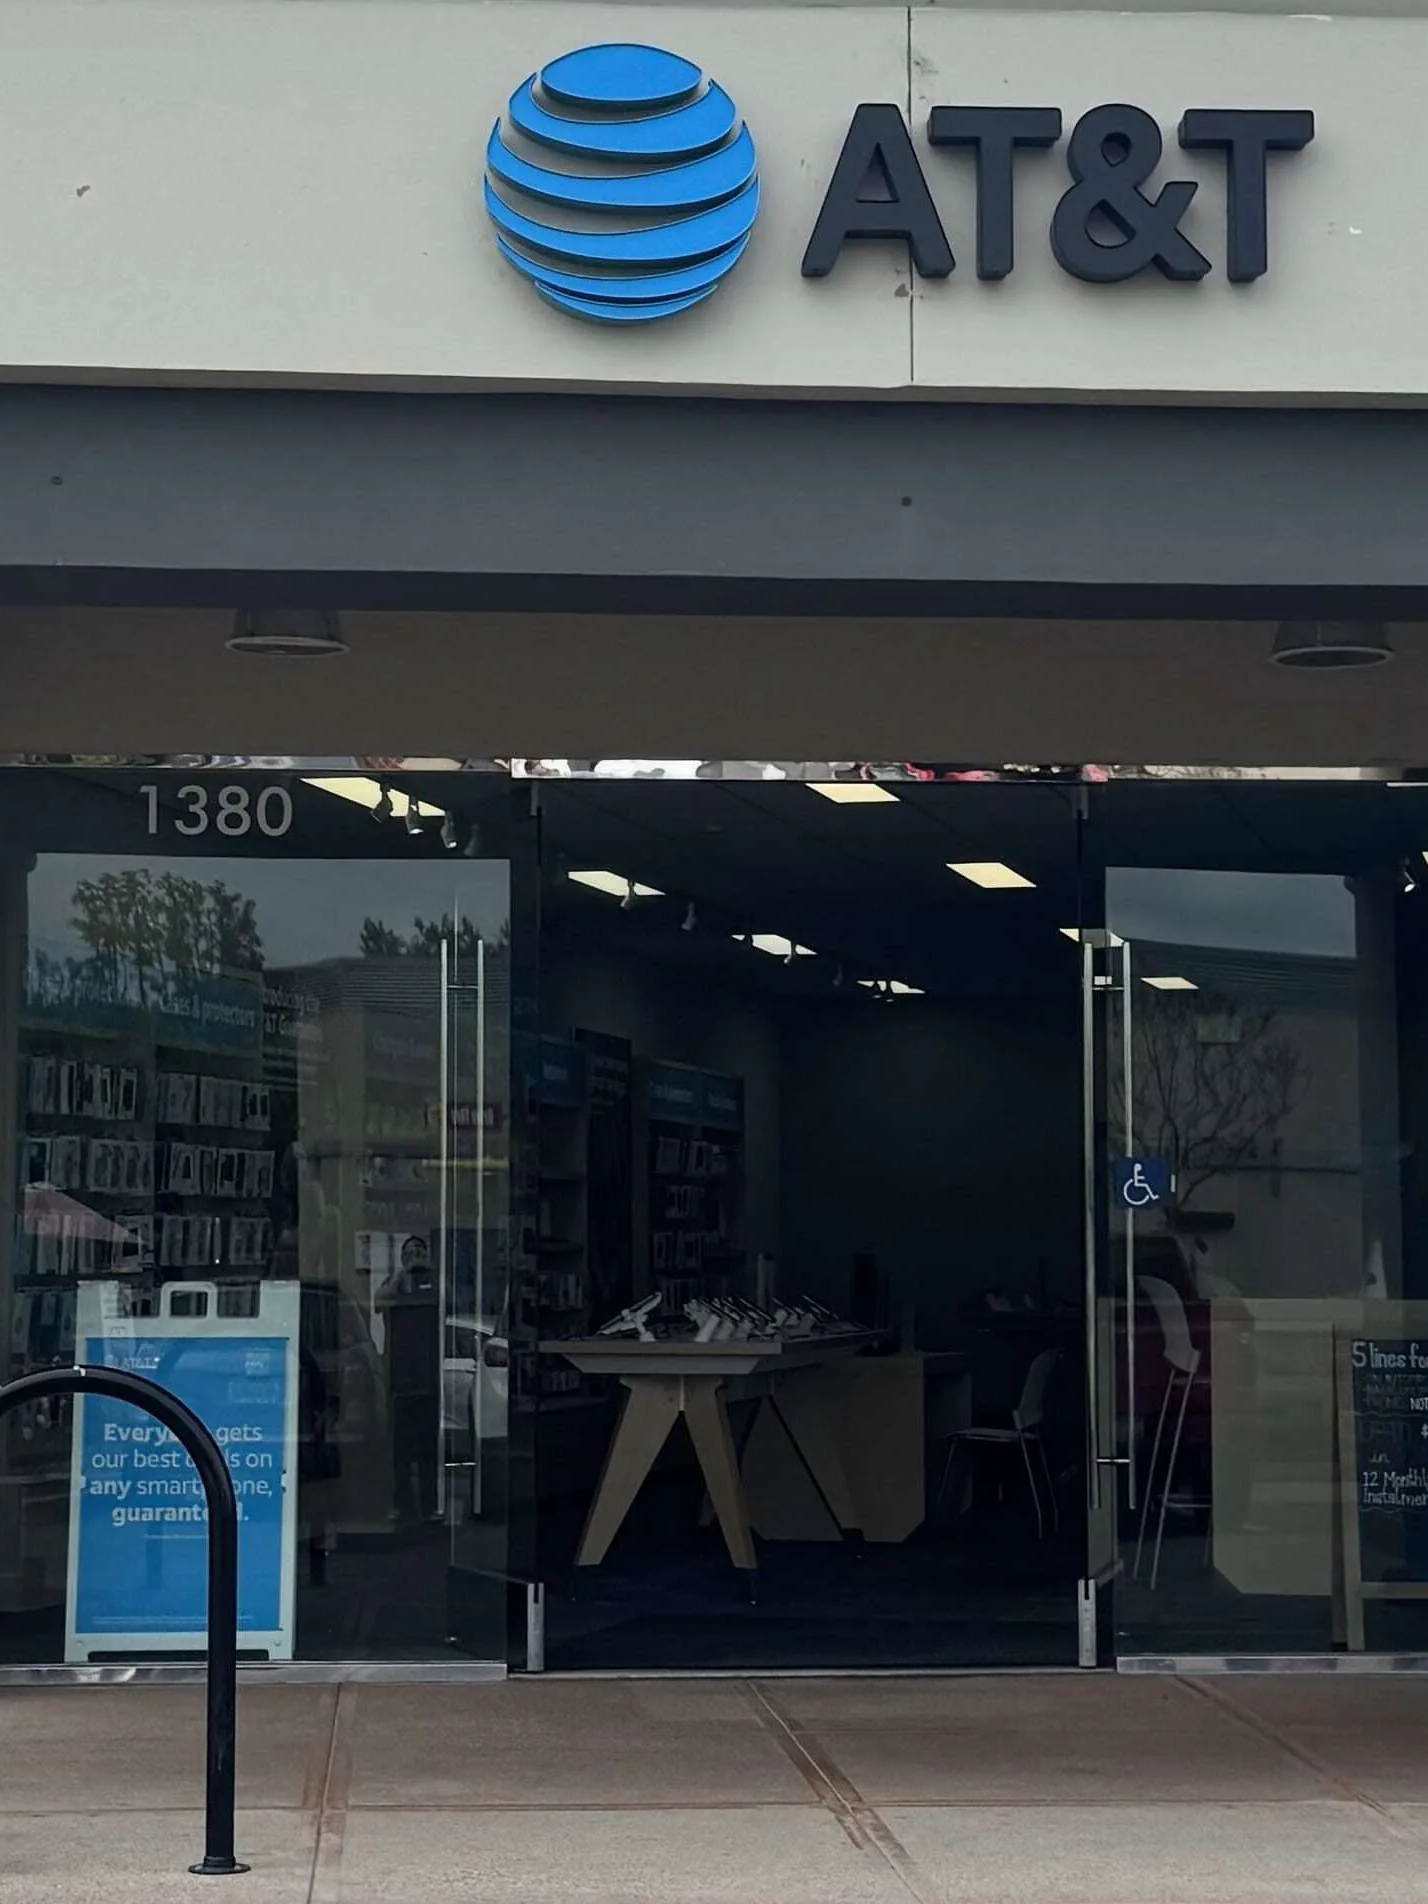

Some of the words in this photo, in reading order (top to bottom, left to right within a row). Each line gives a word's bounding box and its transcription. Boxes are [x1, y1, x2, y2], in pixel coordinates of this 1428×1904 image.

[800, 102, 1315, 283] AT&T
[138, 784, 293, 837] 1380
[1351, 1341, 1367, 1368] 5
[1369, 1342, 1406, 1369] lines
[216, 1424, 263, 1446] gets
[91, 1452, 129, 1468] our
[133, 1449, 181, 1469] best
[245, 1452, 272, 1469] on
[89, 1480, 132, 1500] any
[1361, 1472, 1380, 1487] 12
